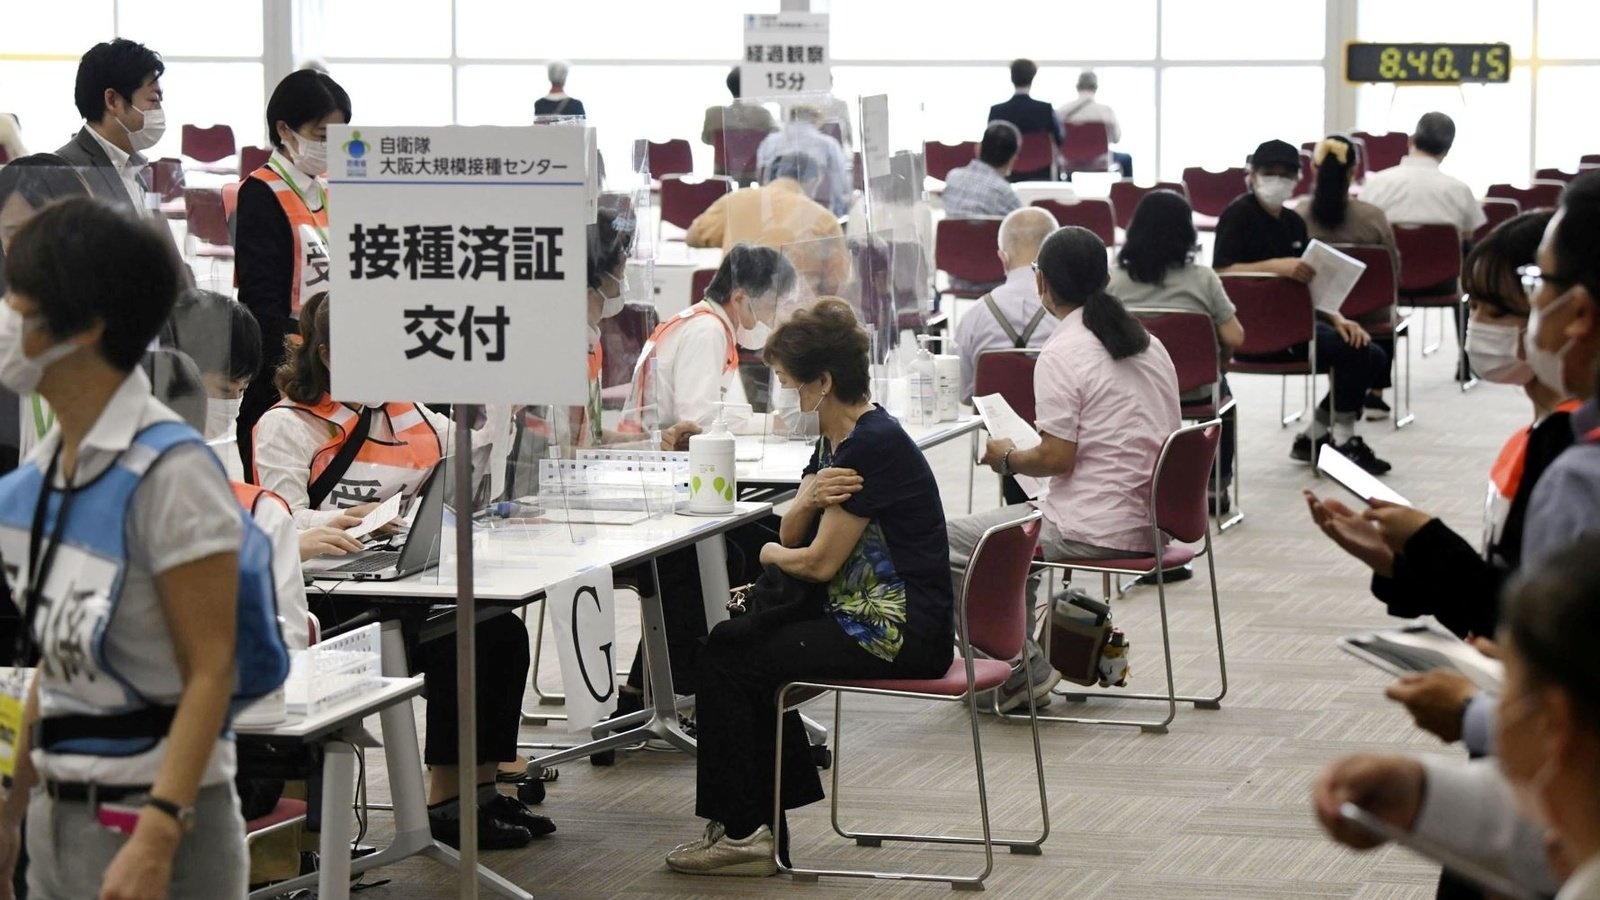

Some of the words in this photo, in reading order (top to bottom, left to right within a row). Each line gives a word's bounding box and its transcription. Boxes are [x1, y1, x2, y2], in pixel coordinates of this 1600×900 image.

[767, 72, 805, 91] 15分
[380, 136, 431, 155] 自衛隊
[380, 157, 568, 176] 大阪大規模接種センター
[349, 223, 565, 282] 接種済証
[403, 304, 511, 362] 交付
[571, 585, 614, 703] G
